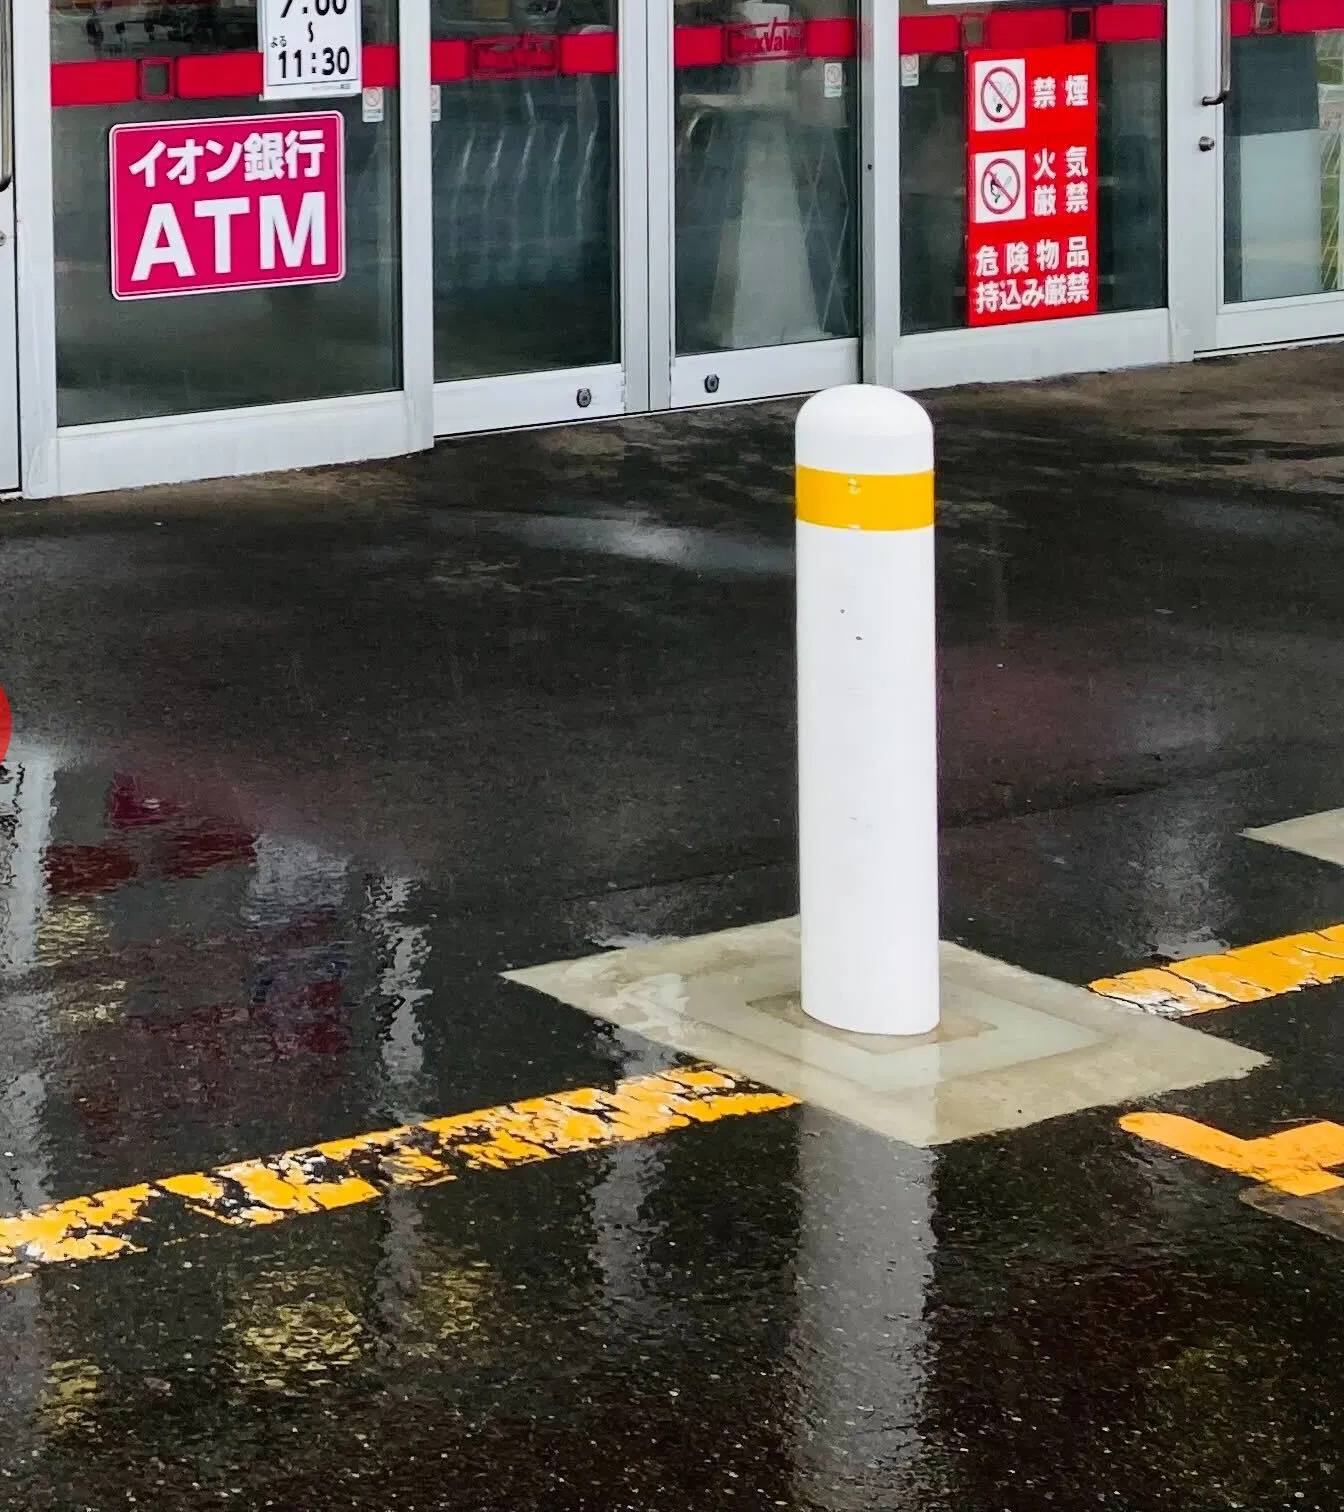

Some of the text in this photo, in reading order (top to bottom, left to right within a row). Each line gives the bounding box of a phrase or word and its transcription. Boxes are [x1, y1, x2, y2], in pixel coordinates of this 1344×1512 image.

[271, 35, 288, 49] よる
[278, 45, 350, 79] 11:30
[1031, 74, 1089, 109] 禁煙
[128, 129, 326, 189] イオン銀行
[1033, 146, 1089, 181] 火気
[1032, 182, 1089, 217] 厳禁
[130, 190, 328, 282] ATM
[974, 235, 1089, 278] 危険物品
[974, 274, 1090, 315] 持込み厳禁
